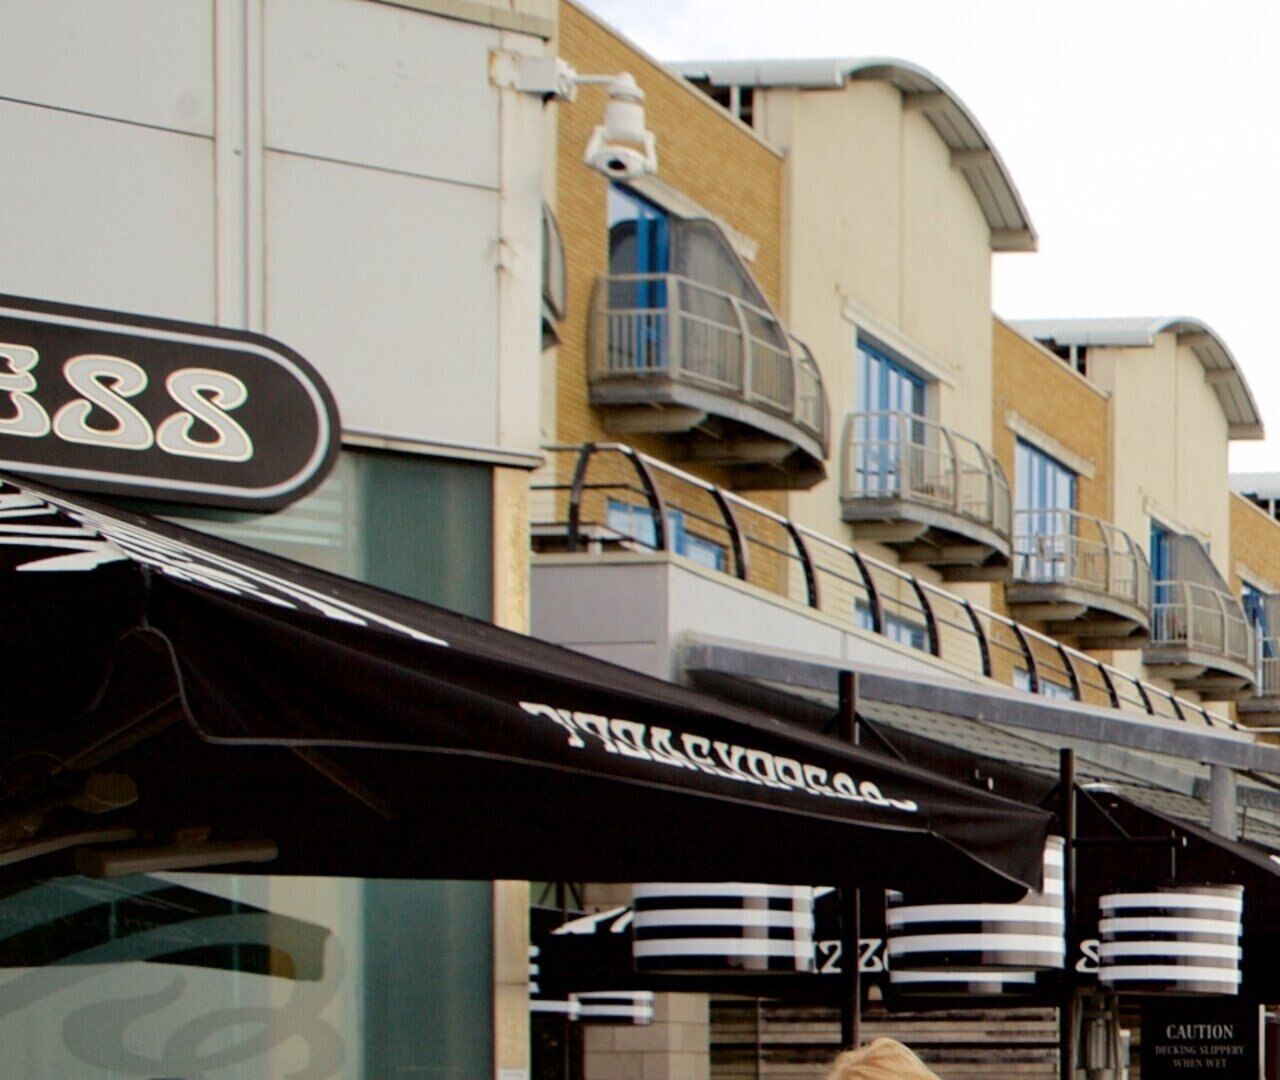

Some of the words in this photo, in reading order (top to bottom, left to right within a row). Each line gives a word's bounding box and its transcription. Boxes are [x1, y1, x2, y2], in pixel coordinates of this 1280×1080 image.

[1166, 1024, 1234, 1039] CAUTION
[1155, 1045, 1197, 1055] DECKING
[1199, 1045, 1245, 1055] SLIPPERY
[1173, 1058, 1202, 1068] WHEN
[1206, 1058, 1228, 1068] WET
